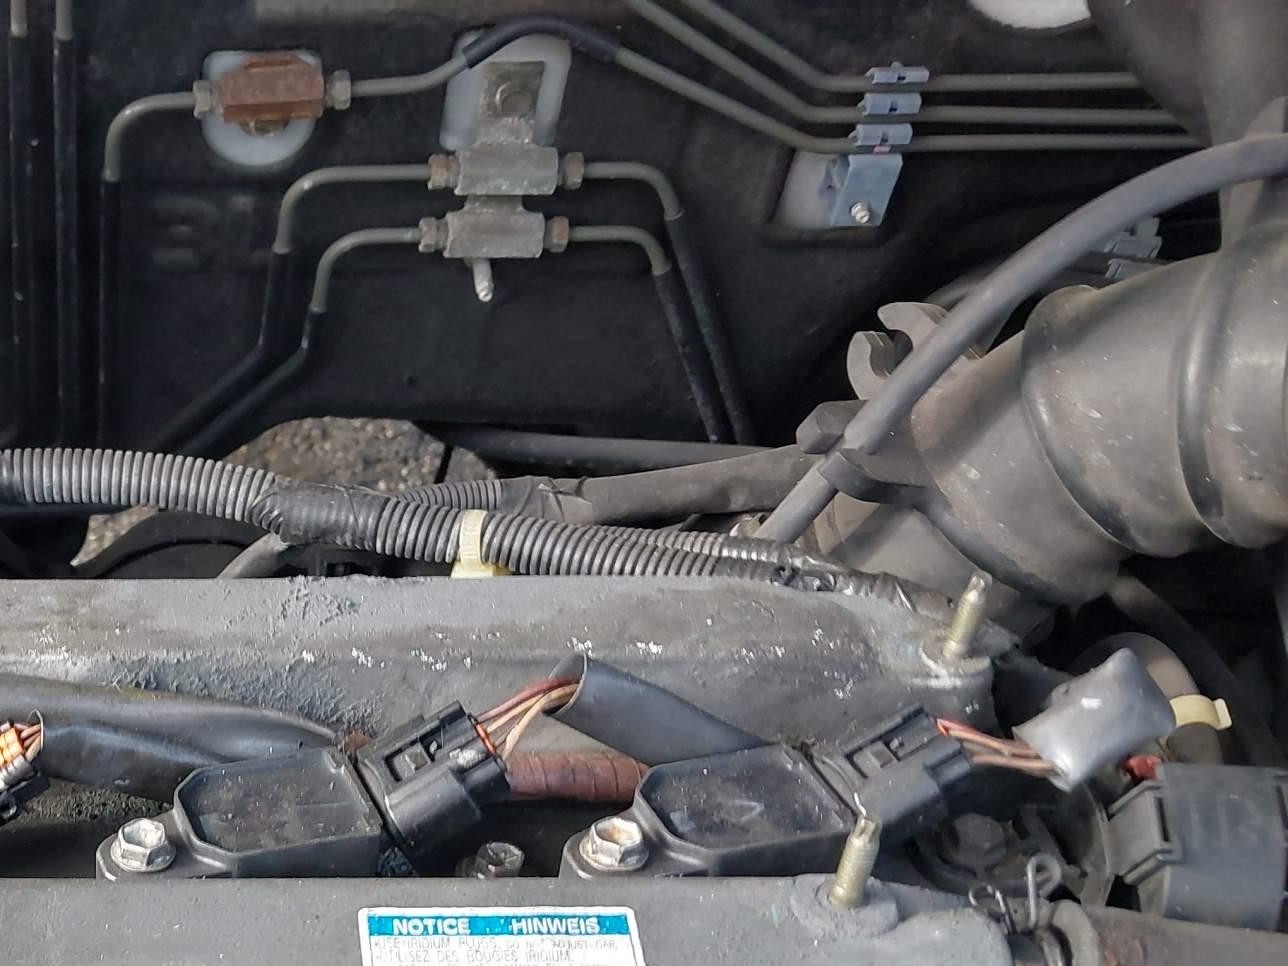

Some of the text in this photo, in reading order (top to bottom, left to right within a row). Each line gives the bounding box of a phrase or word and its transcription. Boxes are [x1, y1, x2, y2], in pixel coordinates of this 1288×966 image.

[392, 917, 600, 936] NOTICE HINWEIS
[379, 937, 401, 949] USE
[407, 936, 450, 949] IRIDIUM
[379, 950, 430, 962] UTILISEZ
[437, 950, 459, 962] DES
[466, 949, 518, 962] BOUGIES
